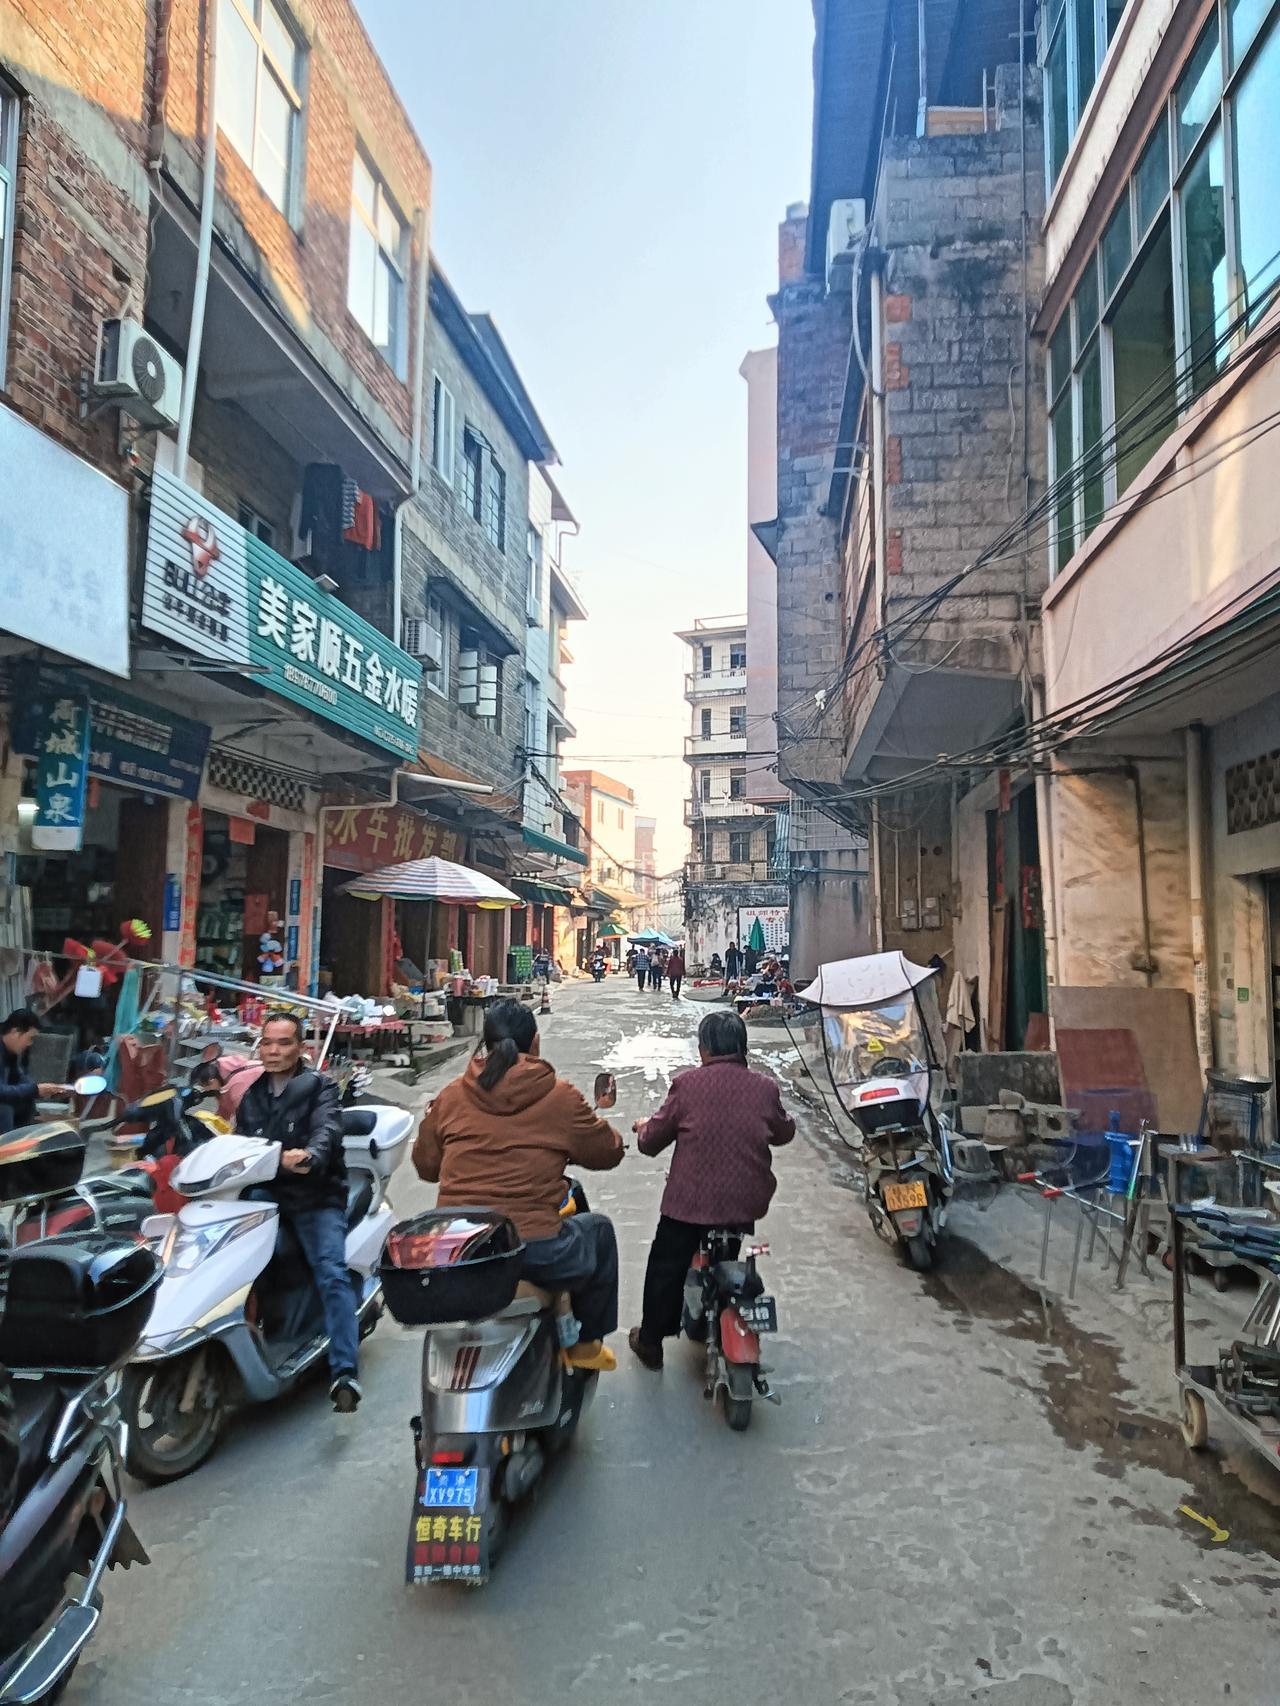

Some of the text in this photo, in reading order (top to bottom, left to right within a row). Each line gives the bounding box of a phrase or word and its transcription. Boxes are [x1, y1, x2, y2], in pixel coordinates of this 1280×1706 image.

[256, 575, 419, 728] 美家顺五金水暖
[415, 1515, 482, 1542] 恒奇车行
